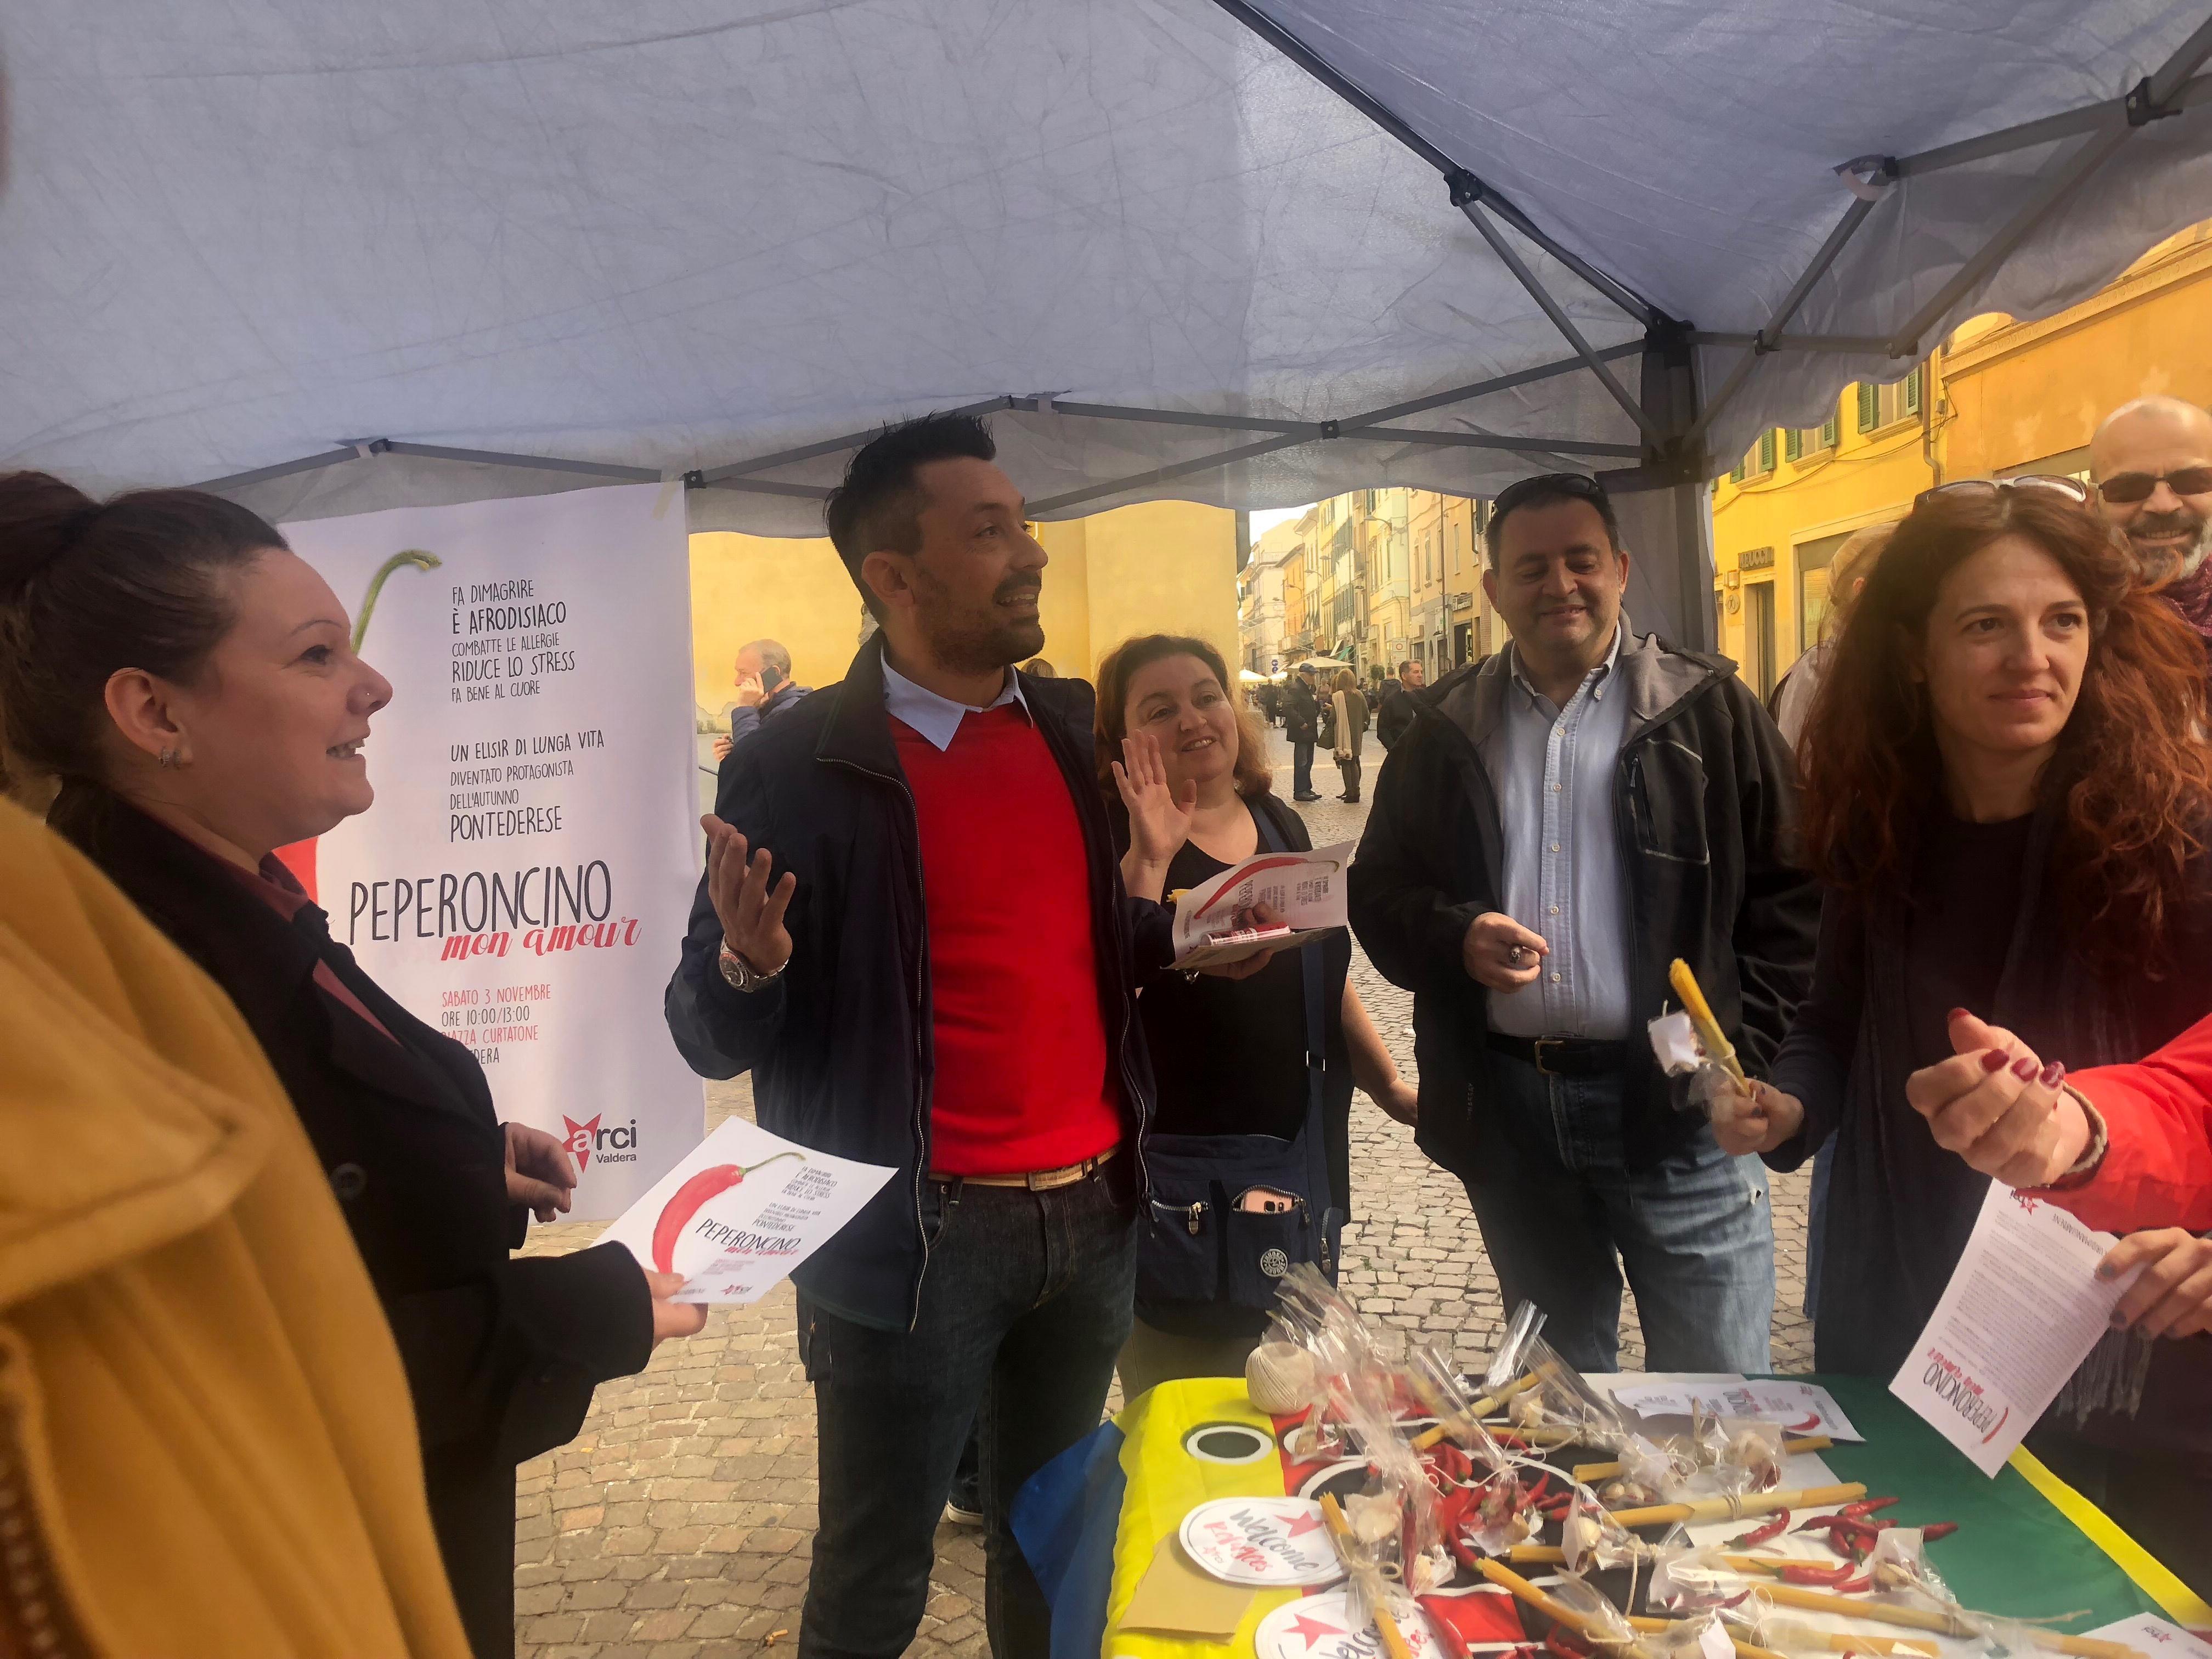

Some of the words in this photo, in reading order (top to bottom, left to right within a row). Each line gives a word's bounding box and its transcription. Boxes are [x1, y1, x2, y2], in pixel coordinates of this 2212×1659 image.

[453, 587, 465, 606] FA
[471, 579, 533, 603] DIMAGRIRE
[453, 608, 460, 634] È
[470, 602, 566, 635] AFRODISIACO
[452, 639, 501, 657] COMBATTE
[507, 637, 516, 652] LE
[522, 633, 559, 651] ALLERGIE
[453, 658, 500, 682] RIDUCE
[509, 657, 523, 678] LO
[531, 651, 574, 675] STRESS
[452, 688, 461, 703] FA
[467, 685, 489, 702] BENE
[495, 684, 505, 699] AL
[511, 680, 540, 697] CUORE
[452, 744, 469, 762] UN
[476, 740, 509, 759] ELISIR
[516, 739, 526, 755] DI
[533, 733, 571, 754] LUNGA
[578, 730, 604, 749] VITA
[451, 768, 501, 786] DIVENTATO
[507, 760, 573, 782] PROTAGONISTA
[450, 789, 518, 810] DELL'AUTUNNO
[451, 806, 562, 842] PONTEDERESE
[350, 860, 612, 945] PEPERONCINO
[441, 928, 512, 961] mon
[523, 917, 642, 956] amour
[443, 990, 478, 1007] SABATO
[486, 989, 490, 1004] 3
[498, 984, 550, 1003] NOVEMBRE
[442, 1011, 460, 1026] ORE
[467, 1006, 529, 1025] 10:00/13:00
[483, 1025, 538, 1043] CURTATONE
[572, 1120, 637, 1152] arci
[596, 1153, 636, 1163] Valdera
[695, 1218, 802, 1251] PEPERONCINO
